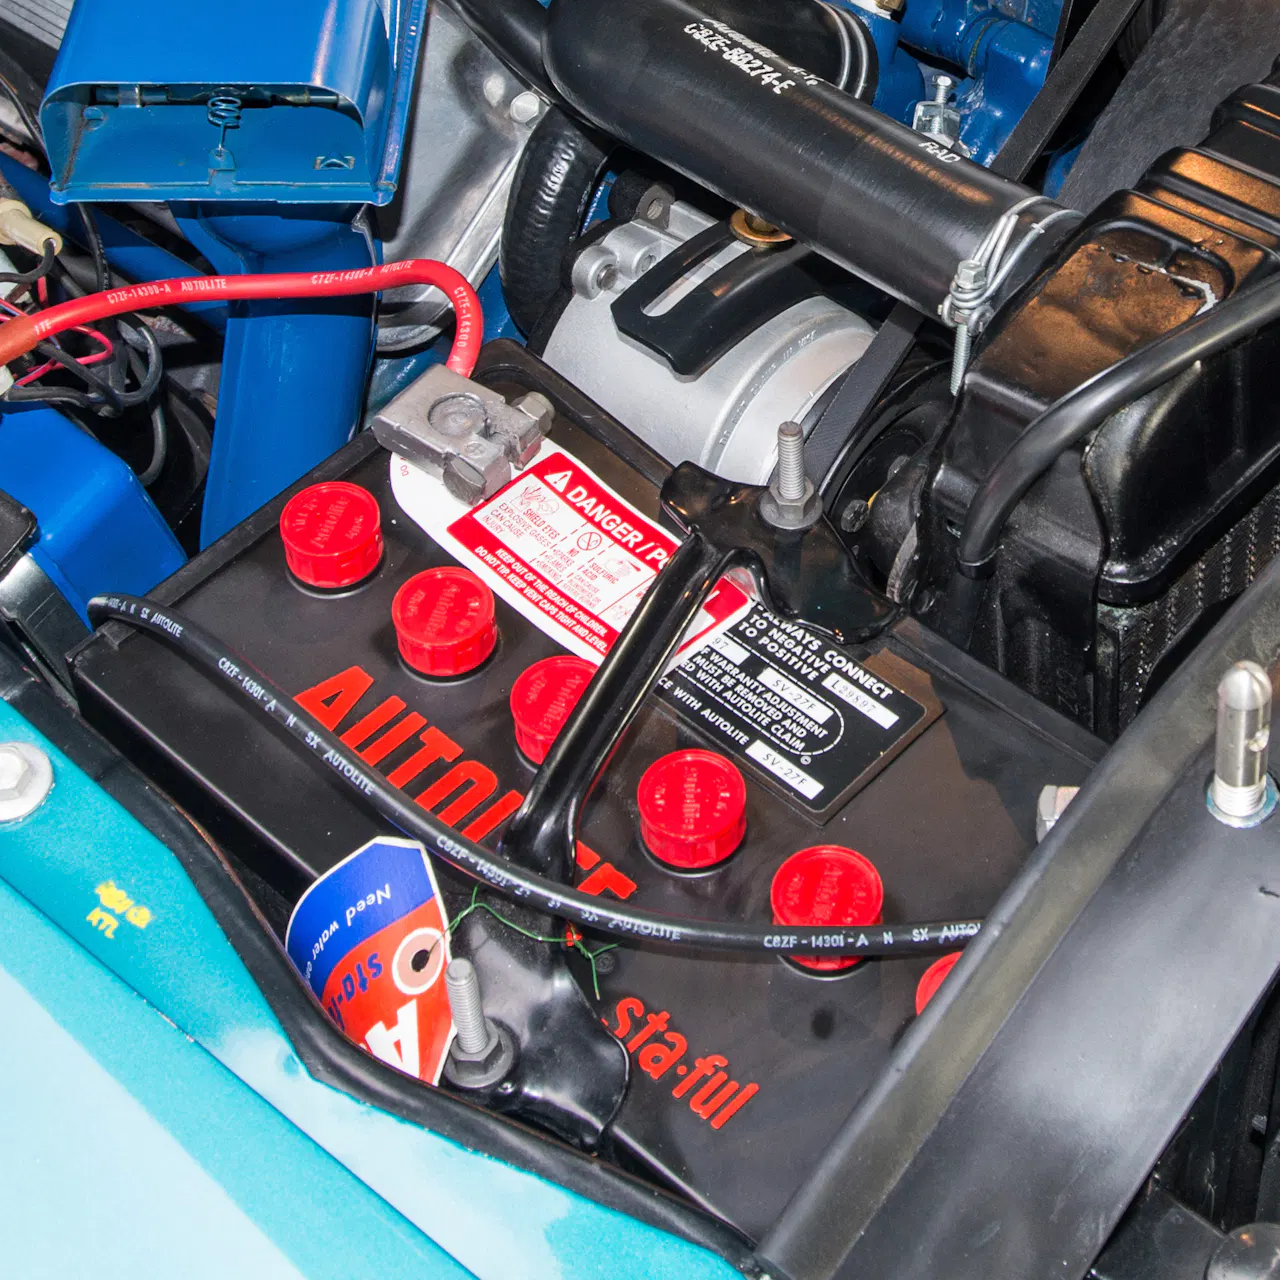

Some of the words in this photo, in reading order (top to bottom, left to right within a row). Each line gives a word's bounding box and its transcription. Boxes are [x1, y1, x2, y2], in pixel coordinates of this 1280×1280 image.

[917, 138, 961, 164] RAD
[181, 278, 227, 292] AUTOLITE
[480, 514, 505, 535] INJURY
[489, 508, 506, 523] CAN
[501, 518, 525, 539] CAUSE
[497, 501, 533, 532] EXPLOSIVE
[528, 528, 552, 548] GASES
[522, 507, 545, 529] SHIELD
[541, 524, 560, 541] EYES
[564, 487, 645, 548] DANGER
[566, 547, 580, 558] NO
[589, 562, 619, 585] SULFURIC
[494, 548, 513, 564] KEEP
[510, 560, 527, 575] OUT
[523, 570, 537, 583] OF
[532, 578, 548, 592] THE
[543, 588, 568, 608] REACH
[563, 603, 577, 615] OF
[572, 610, 608, 637] CHILDREN.
[580, 568, 598, 581] ACID
[473, 545, 488, 557] DO
[483, 553, 499, 567] NOT
[495, 563, 510, 577] TIP.
[506, 573, 525, 589] KEEP
[521, 585, 541, 602] VENT
[537, 598, 558, 615] CAPS
[553, 610, 574, 627] TIGHT
[569, 622, 587, 637] AND
[583, 633, 609, 654] LEVEL.
[150, 611, 183, 638] AUTOLITE
[748, 613, 769, 632] TO
[766, 626, 832, 675] NEGATIVE
[737, 620, 759, 640] TO
[757, 635, 820, 682] POSITIVE
[771, 678, 817, 712] SV-27F
[821, 647, 893, 700] CONNECT
[692, 654, 722, 678] MUST
[720, 673, 736, 688] BE
[733, 683, 784, 722] REMOVED
[780, 717, 808, 739] AND
[694, 669, 724, 693] WITH
[721, 690, 772, 728] AUTOLITE
[769, 723, 806, 752] CLAIM
[706, 652, 765, 696] WARRANTY
[760, 690, 828, 739] ADJUSTMENT
[672, 686, 703, 711] WITH
[699, 707, 750, 746] AUTOLITE
[761, 751, 808, 787] SV-27F
[305, 730, 321, 750] SX
[323, 749, 376, 796] AUTOLITE
[345, 884, 391, 927] Need
[312, 920, 339, 960] water
[883, 932, 893, 944] N
[912, 928, 929, 942] SX
